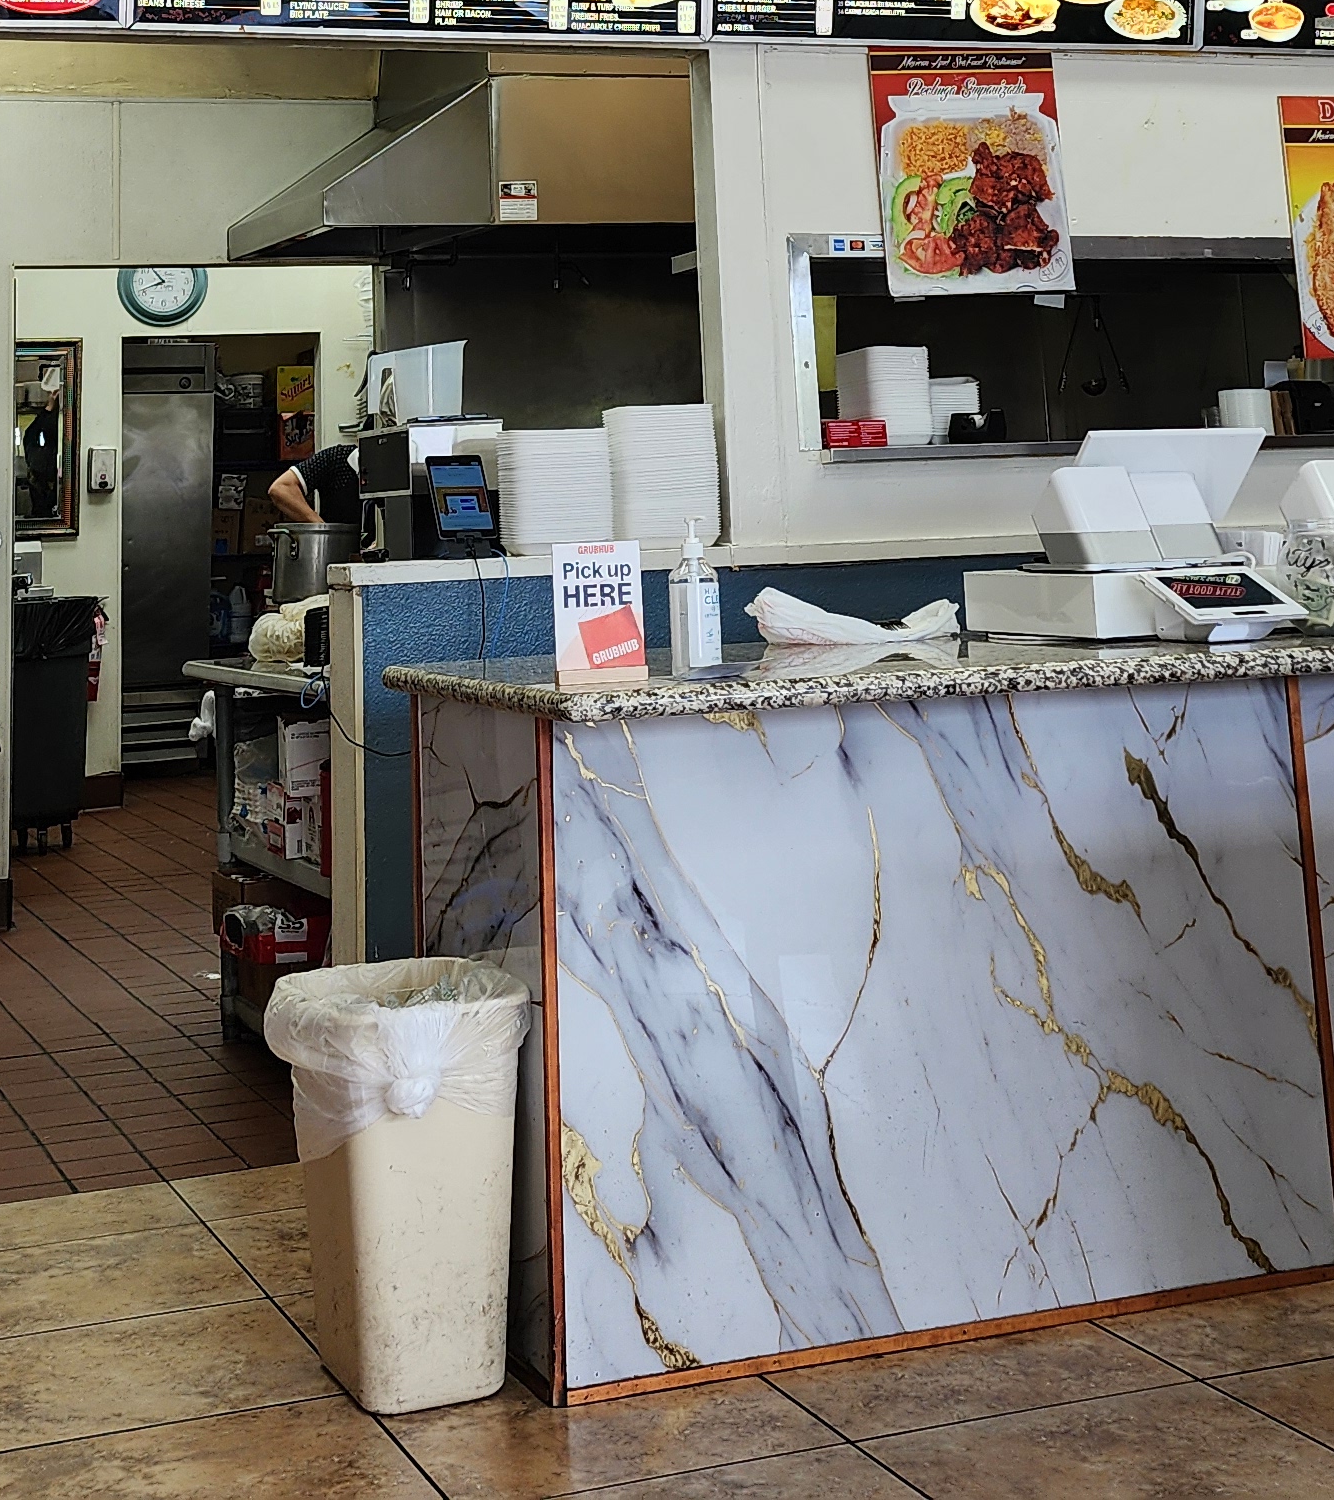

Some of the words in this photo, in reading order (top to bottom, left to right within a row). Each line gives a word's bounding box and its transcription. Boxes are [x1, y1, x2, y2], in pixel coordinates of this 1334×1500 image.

[907, 77, 957, 101] Pechuga
[961, 76, 1027, 100] Empanizada
[578, 544, 615, 554] GRUBHUB
[563, 562, 603, 580] Pick
[607, 563, 632, 580] up
[563, 582, 632, 608] HERE
[592, 638, 640, 665] GRUBHUB
